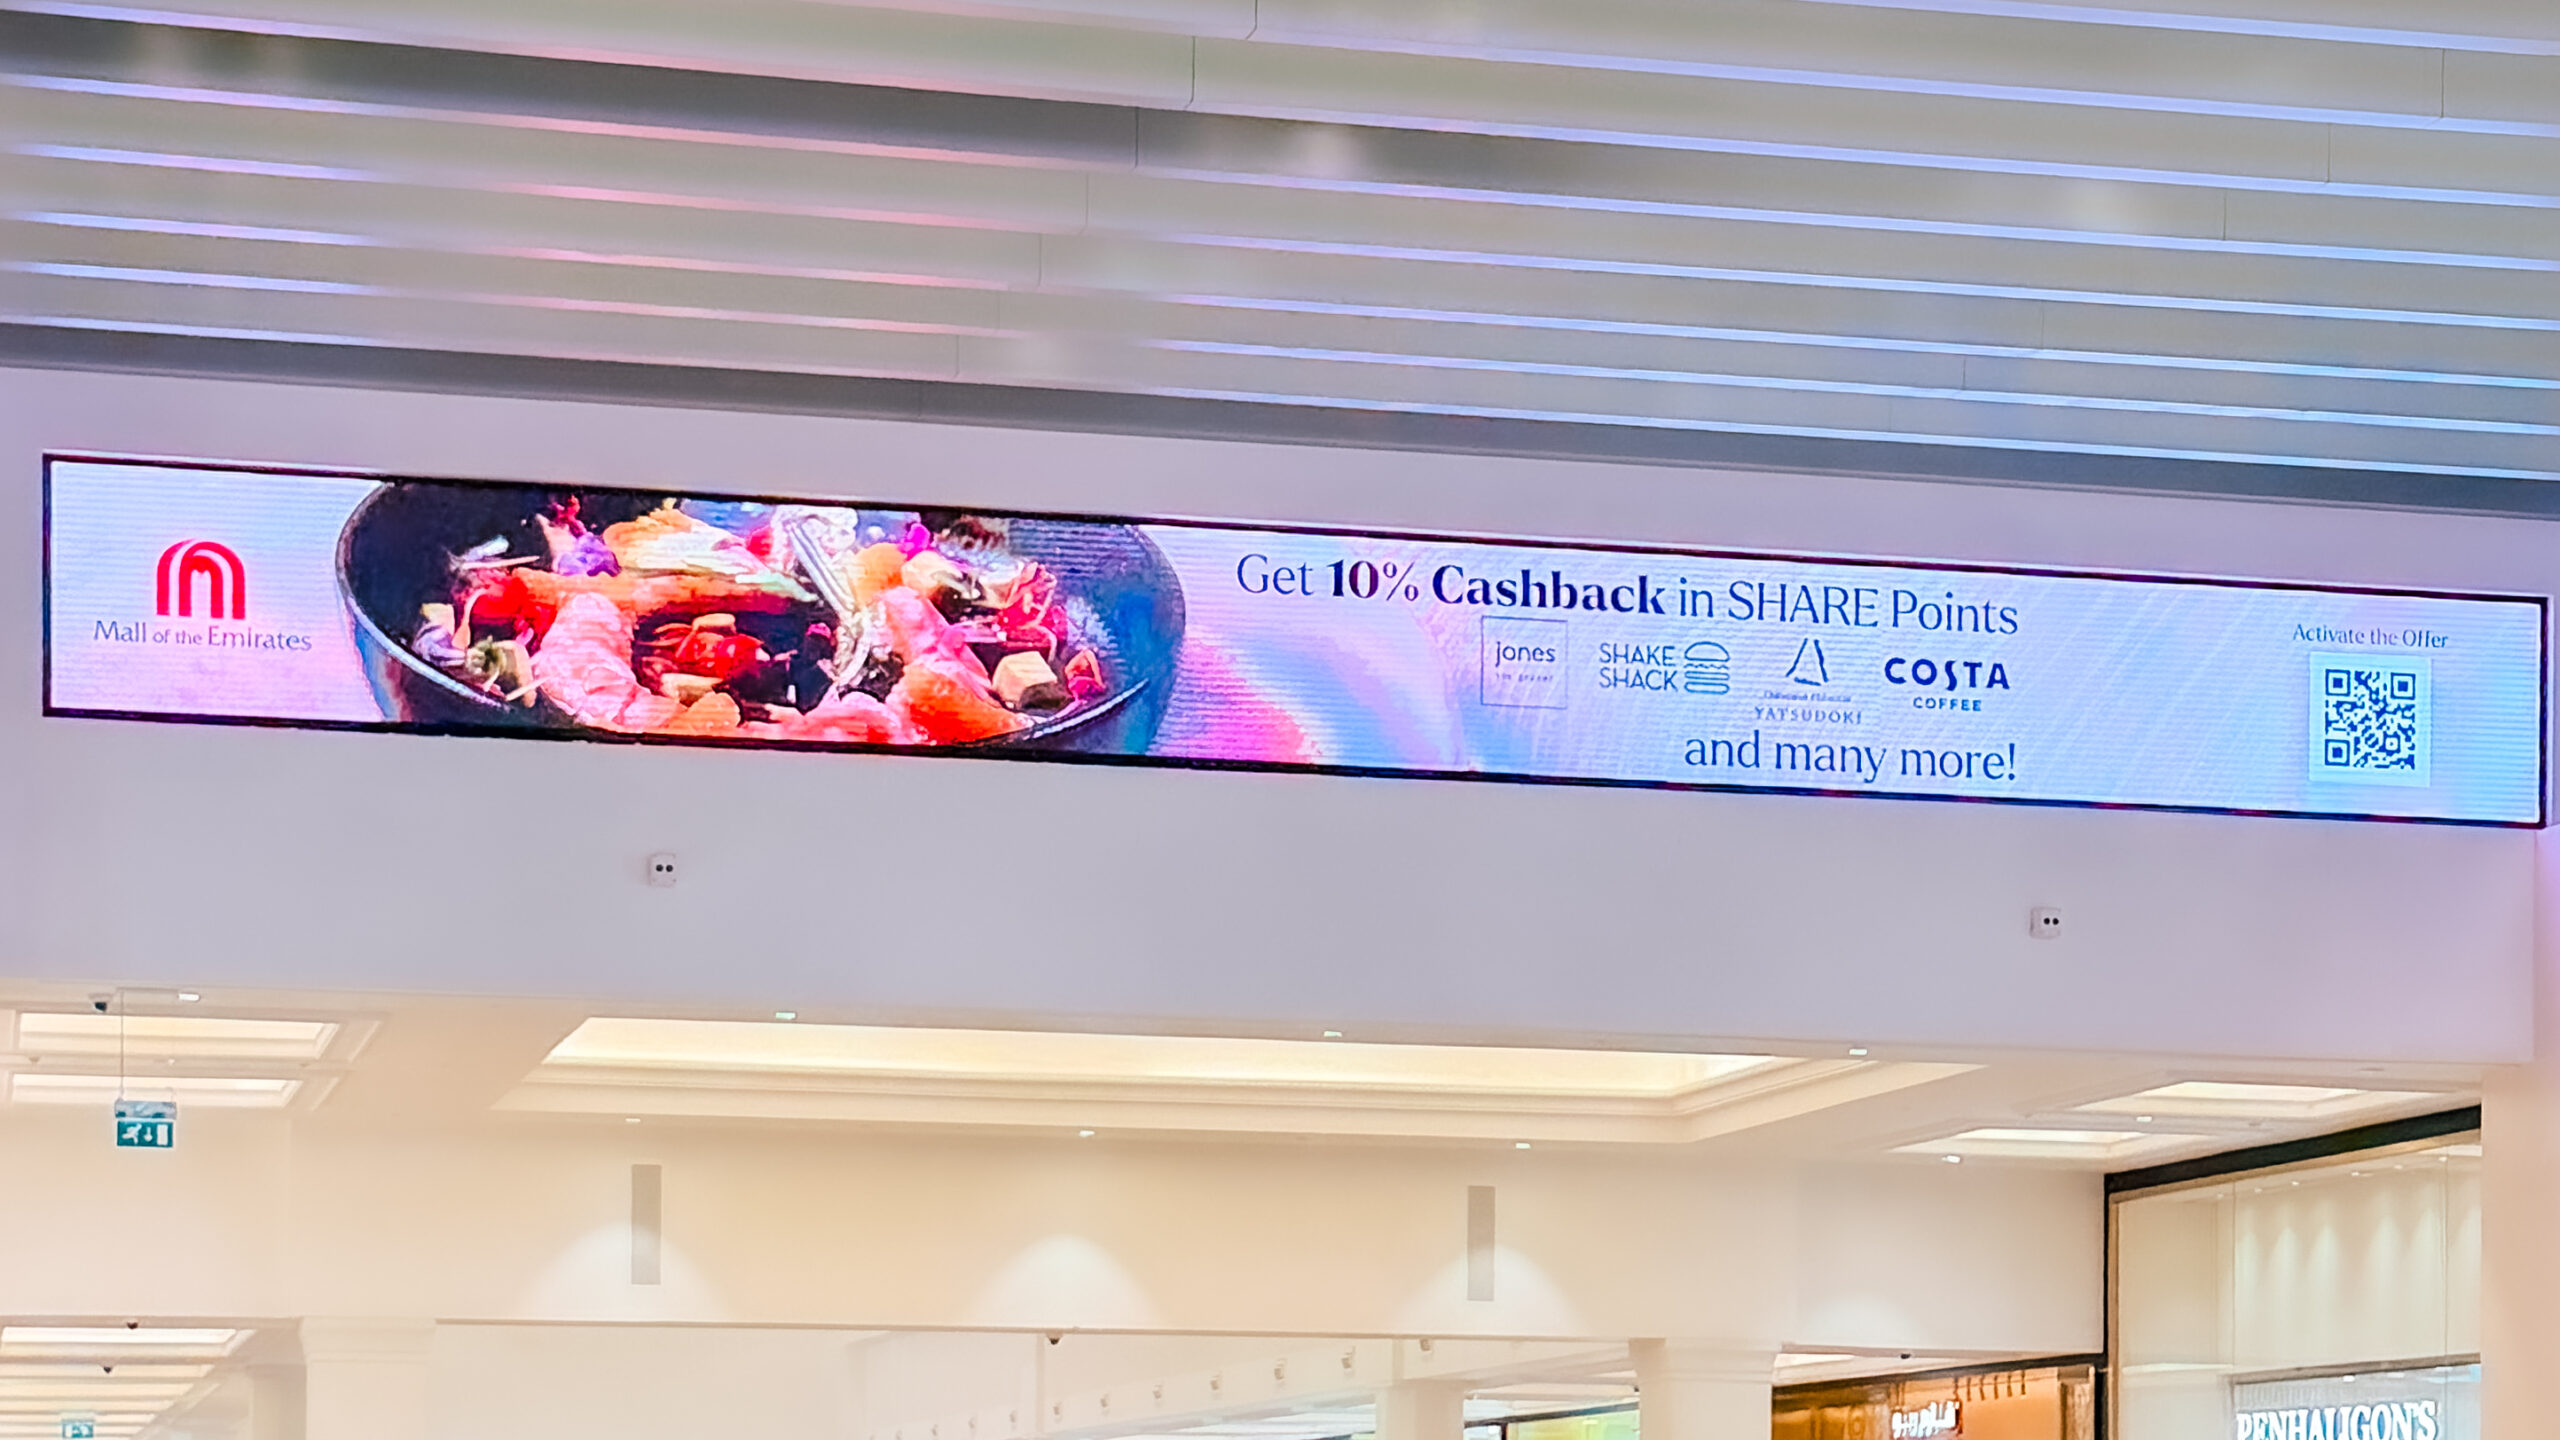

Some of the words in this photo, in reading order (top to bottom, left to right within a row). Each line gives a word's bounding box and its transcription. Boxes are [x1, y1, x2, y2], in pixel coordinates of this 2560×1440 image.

[1236, 553, 1315, 596] Get
[1327, 559, 1420, 602] 10%
[1431, 564, 1666, 615] Cashback
[1679, 577, 1714, 618] in
[1728, 580, 1879, 628] SHARE
[1892, 589, 2019, 635] Points
[93, 619, 147, 643] Mall
[152, 629, 172, 644] of
[175, 629, 203, 645] the
[208, 624, 313, 651] Emirates
[2293, 624, 2365, 645] Activate
[2370, 628, 2399, 646] the
[2402, 629, 2449, 649] Offer
[1495, 641, 1556, 668] jones
[1600, 643, 1677, 667] SHAKE
[1599, 667, 1678, 692] SHACK
[1884, 657, 2010, 691] COSTA
[1754, 706, 1862, 725] YATSUDOKI
[1913, 697, 1982, 712] COFFEE
[1684, 730, 1760, 769] and
[1774, 742, 1887, 783] many
[1900, 743, 2016, 781] more!
[2236, 1401, 2438, 1440] PENHALIGON'S
